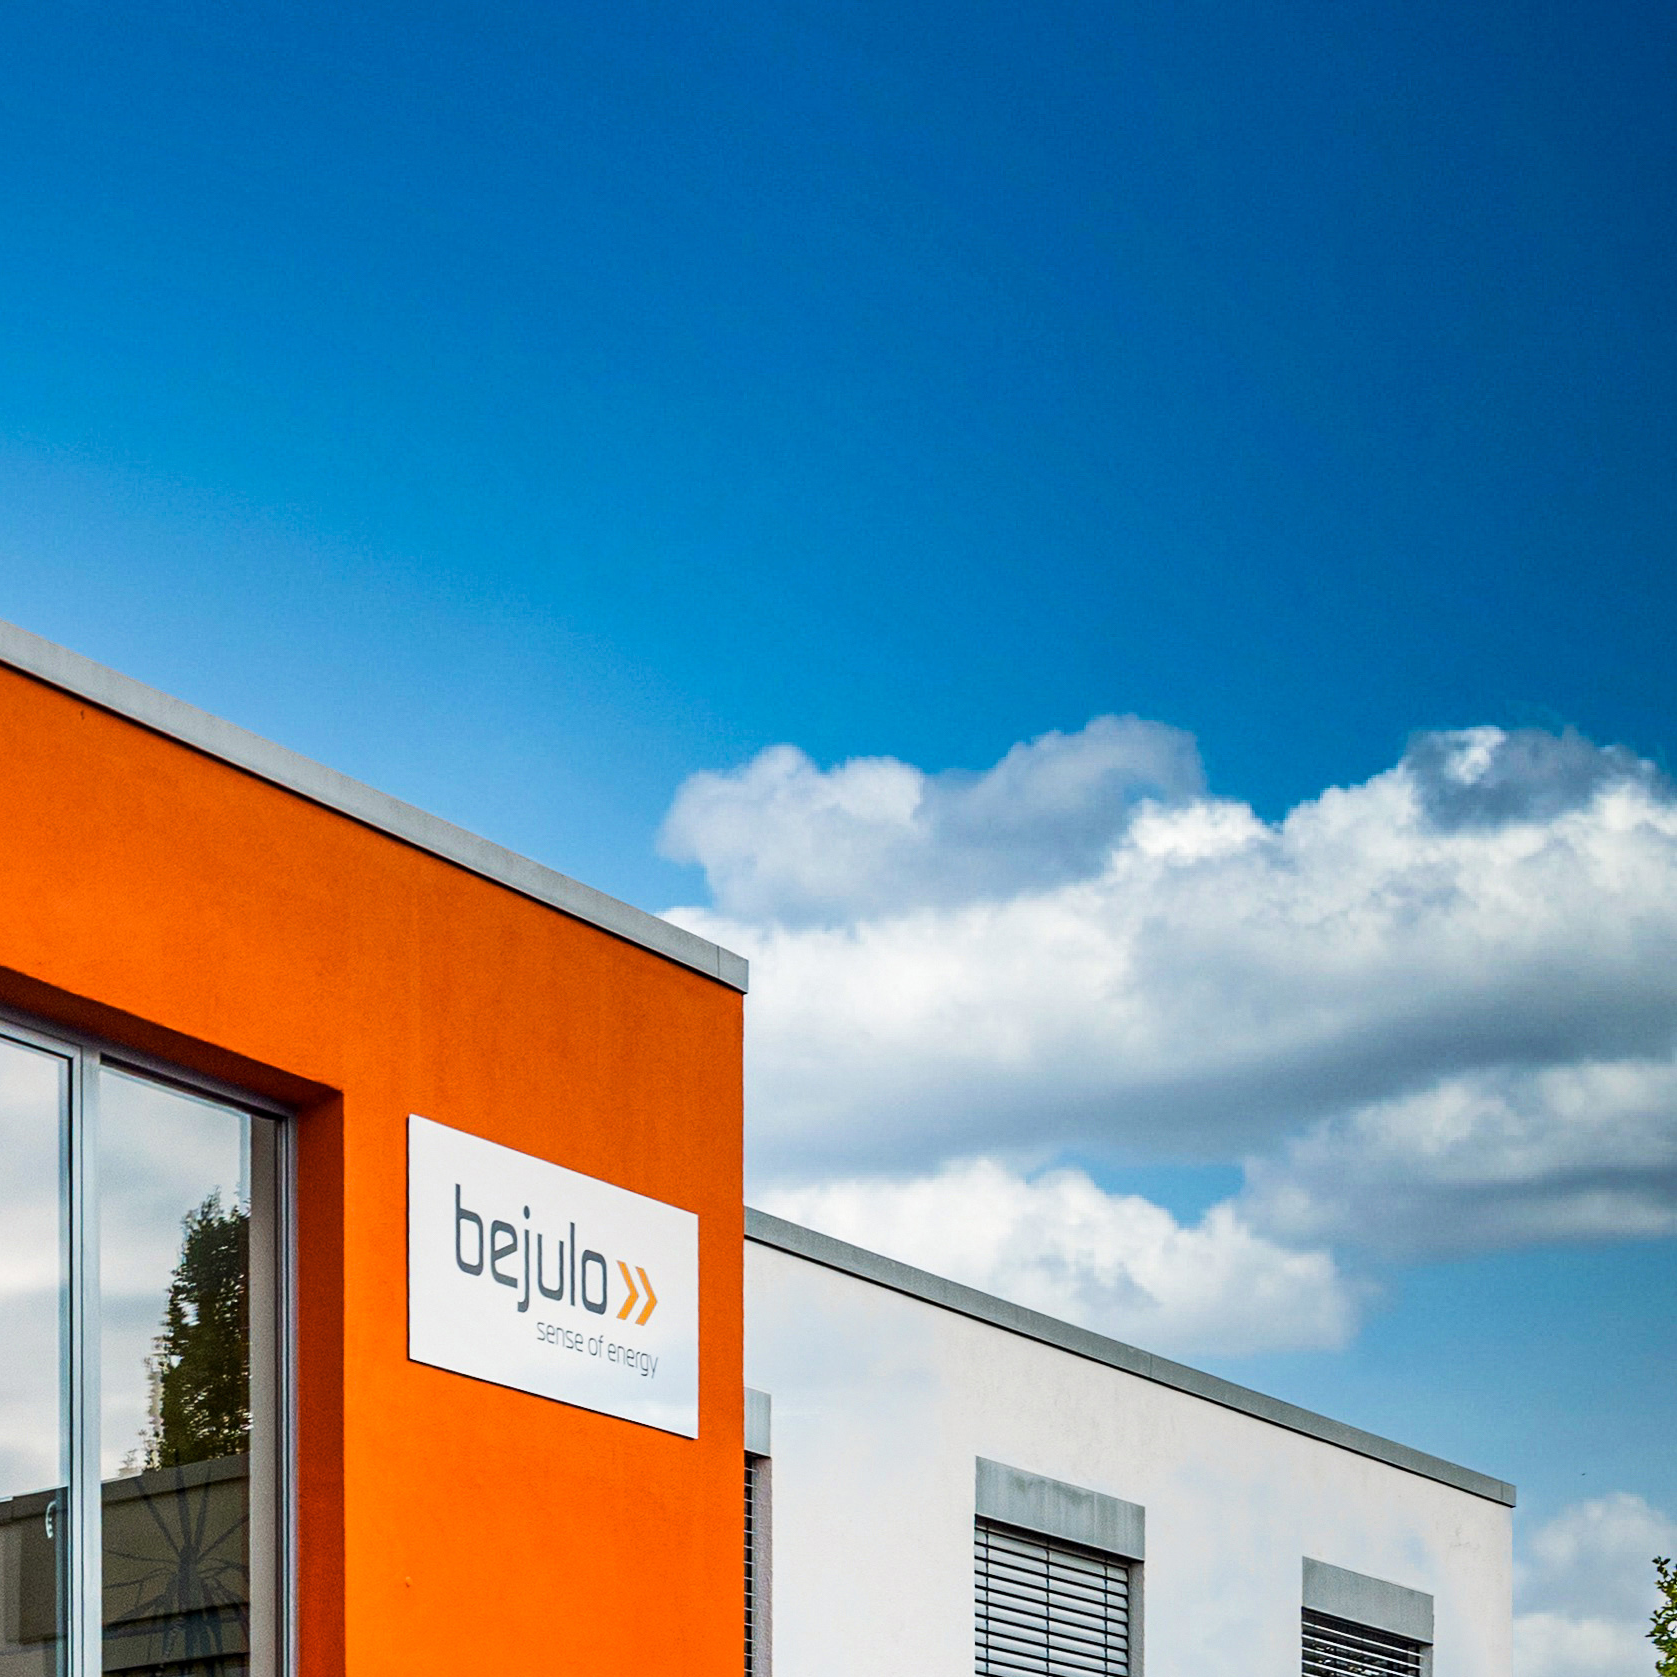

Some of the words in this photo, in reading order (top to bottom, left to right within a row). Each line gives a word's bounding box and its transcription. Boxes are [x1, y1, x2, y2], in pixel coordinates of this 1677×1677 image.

[455, 1183, 607, 1315] bejulo
[537, 1322, 584, 1352] sense
[588, 1335, 604, 1358] of
[607, 1343, 659, 1379] energy
